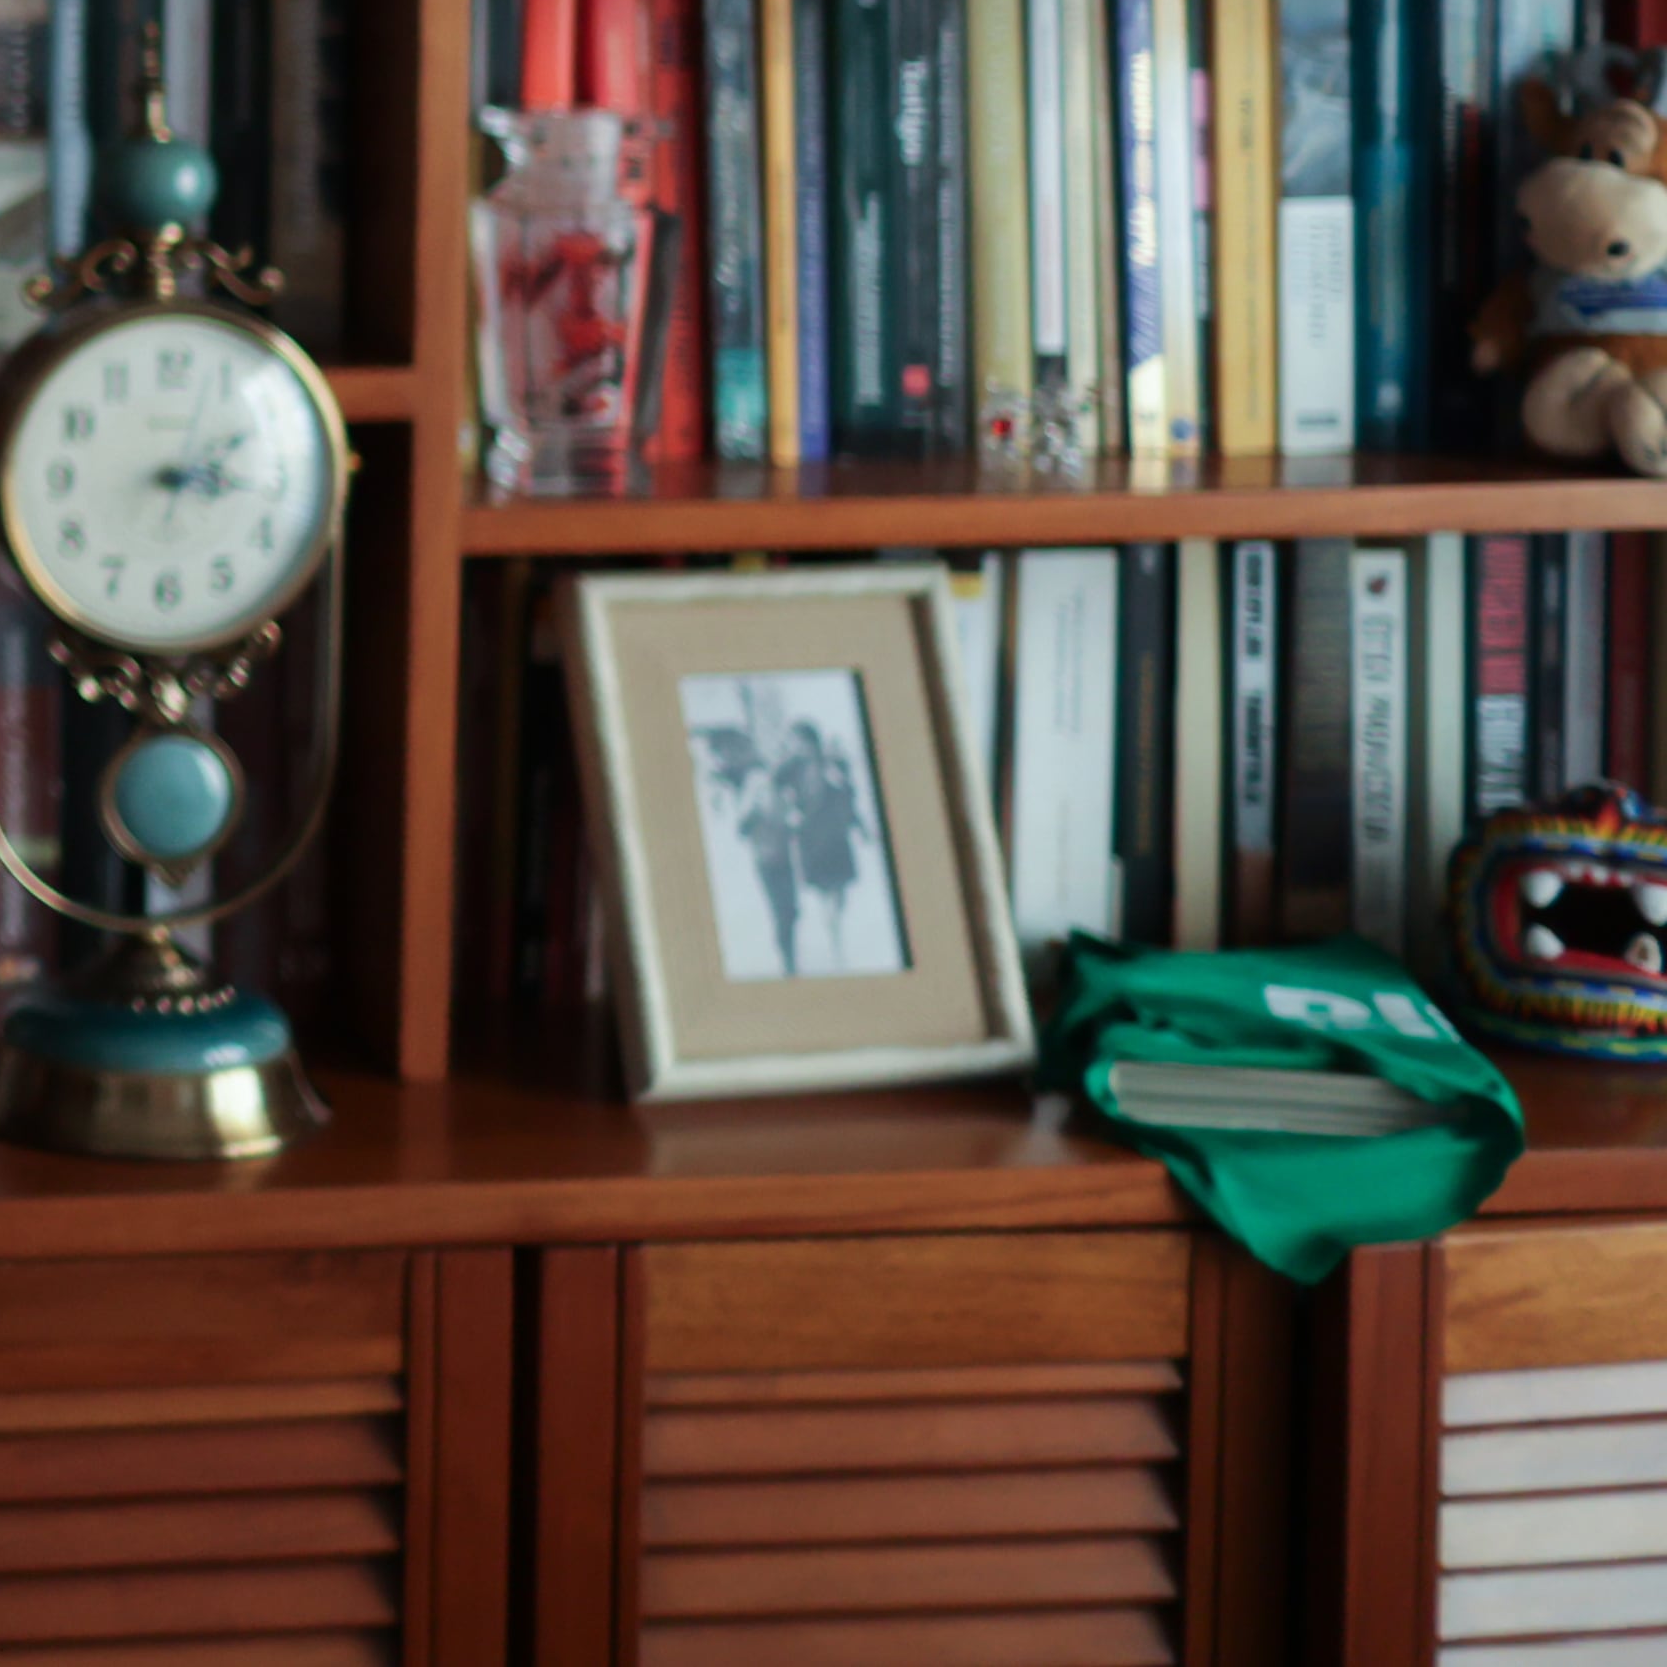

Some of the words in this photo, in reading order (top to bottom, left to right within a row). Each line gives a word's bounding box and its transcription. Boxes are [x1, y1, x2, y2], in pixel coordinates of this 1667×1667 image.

[155, 347, 192, 390] 12
[64, 402, 96, 443] 10
[46, 460, 75, 499] 9
[58, 517, 87, 557] 8
[99, 557, 126, 597] 7
[153, 570, 183, 612] 6
[209, 555, 235, 593] 5
